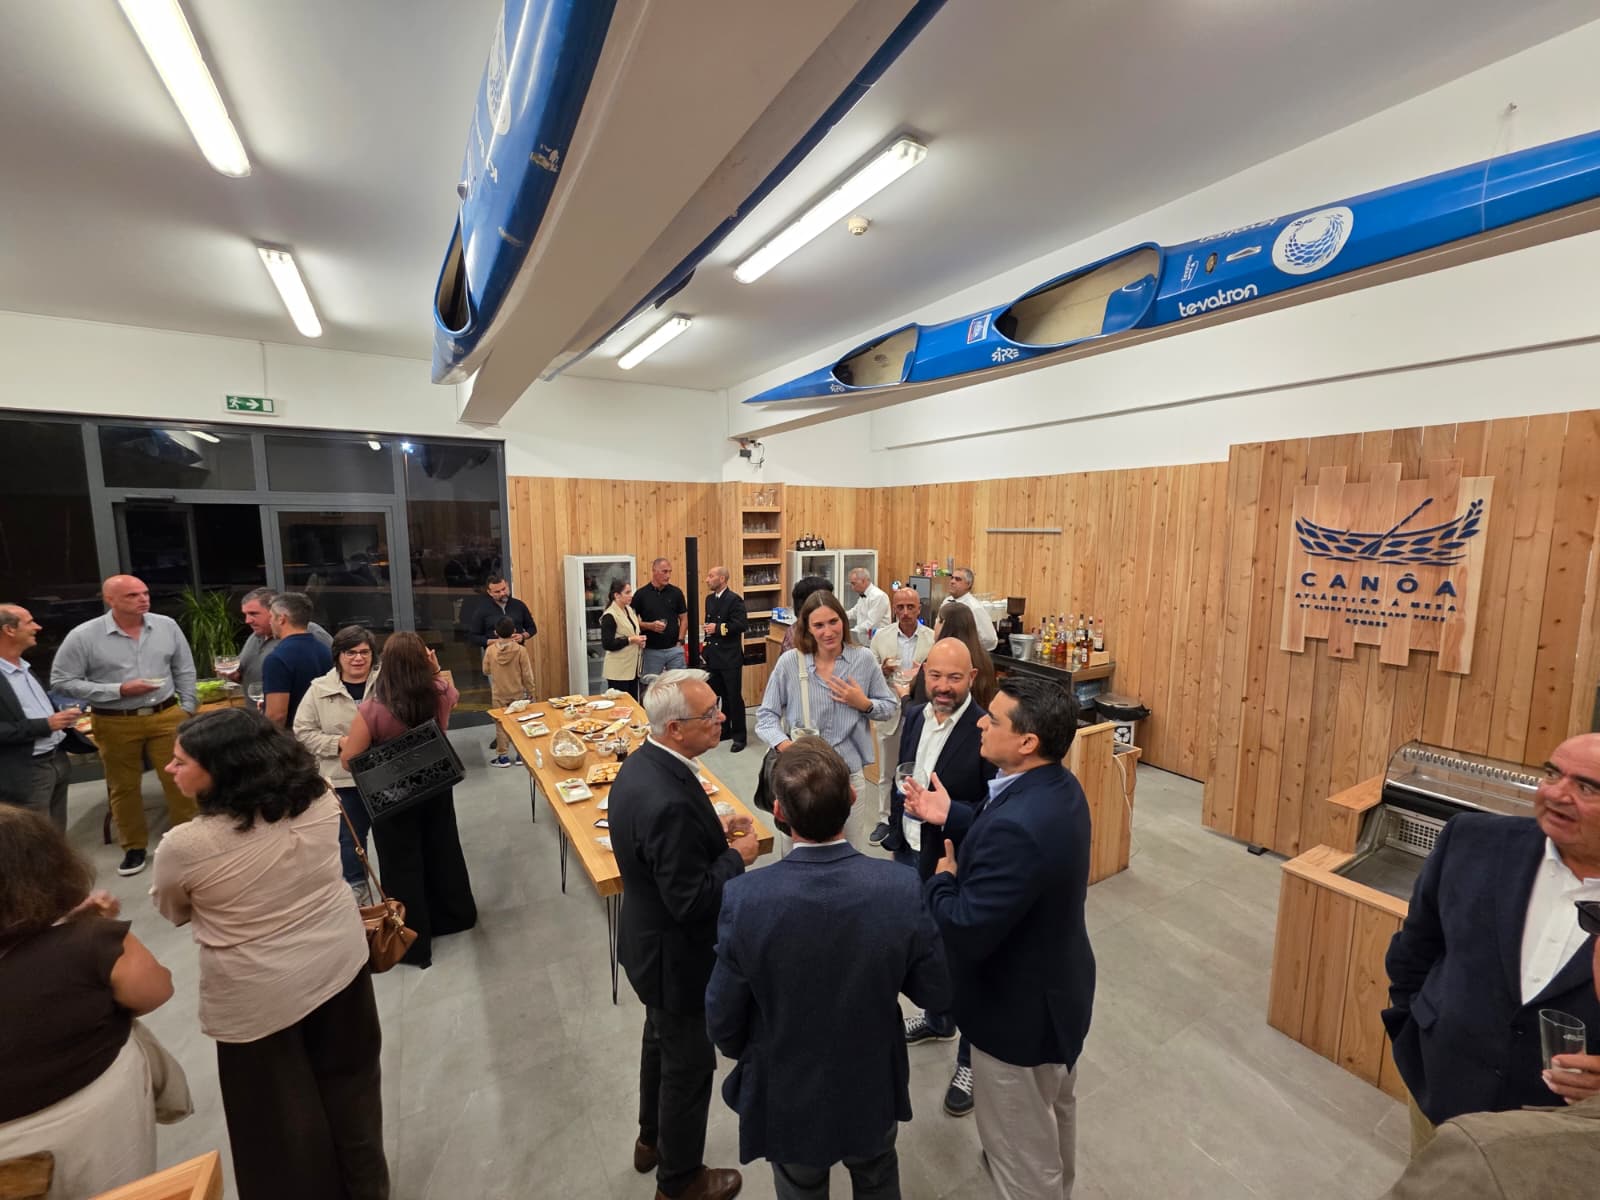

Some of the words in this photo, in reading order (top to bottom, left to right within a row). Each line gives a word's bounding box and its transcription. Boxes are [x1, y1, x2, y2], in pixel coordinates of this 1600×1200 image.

[1178, 283, 1258, 317] tevatron
[1301, 572, 1457, 597] CANÔA
[1345, 607, 1377, 616] NAVAL
[1410, 601, 1457, 613] MESA
